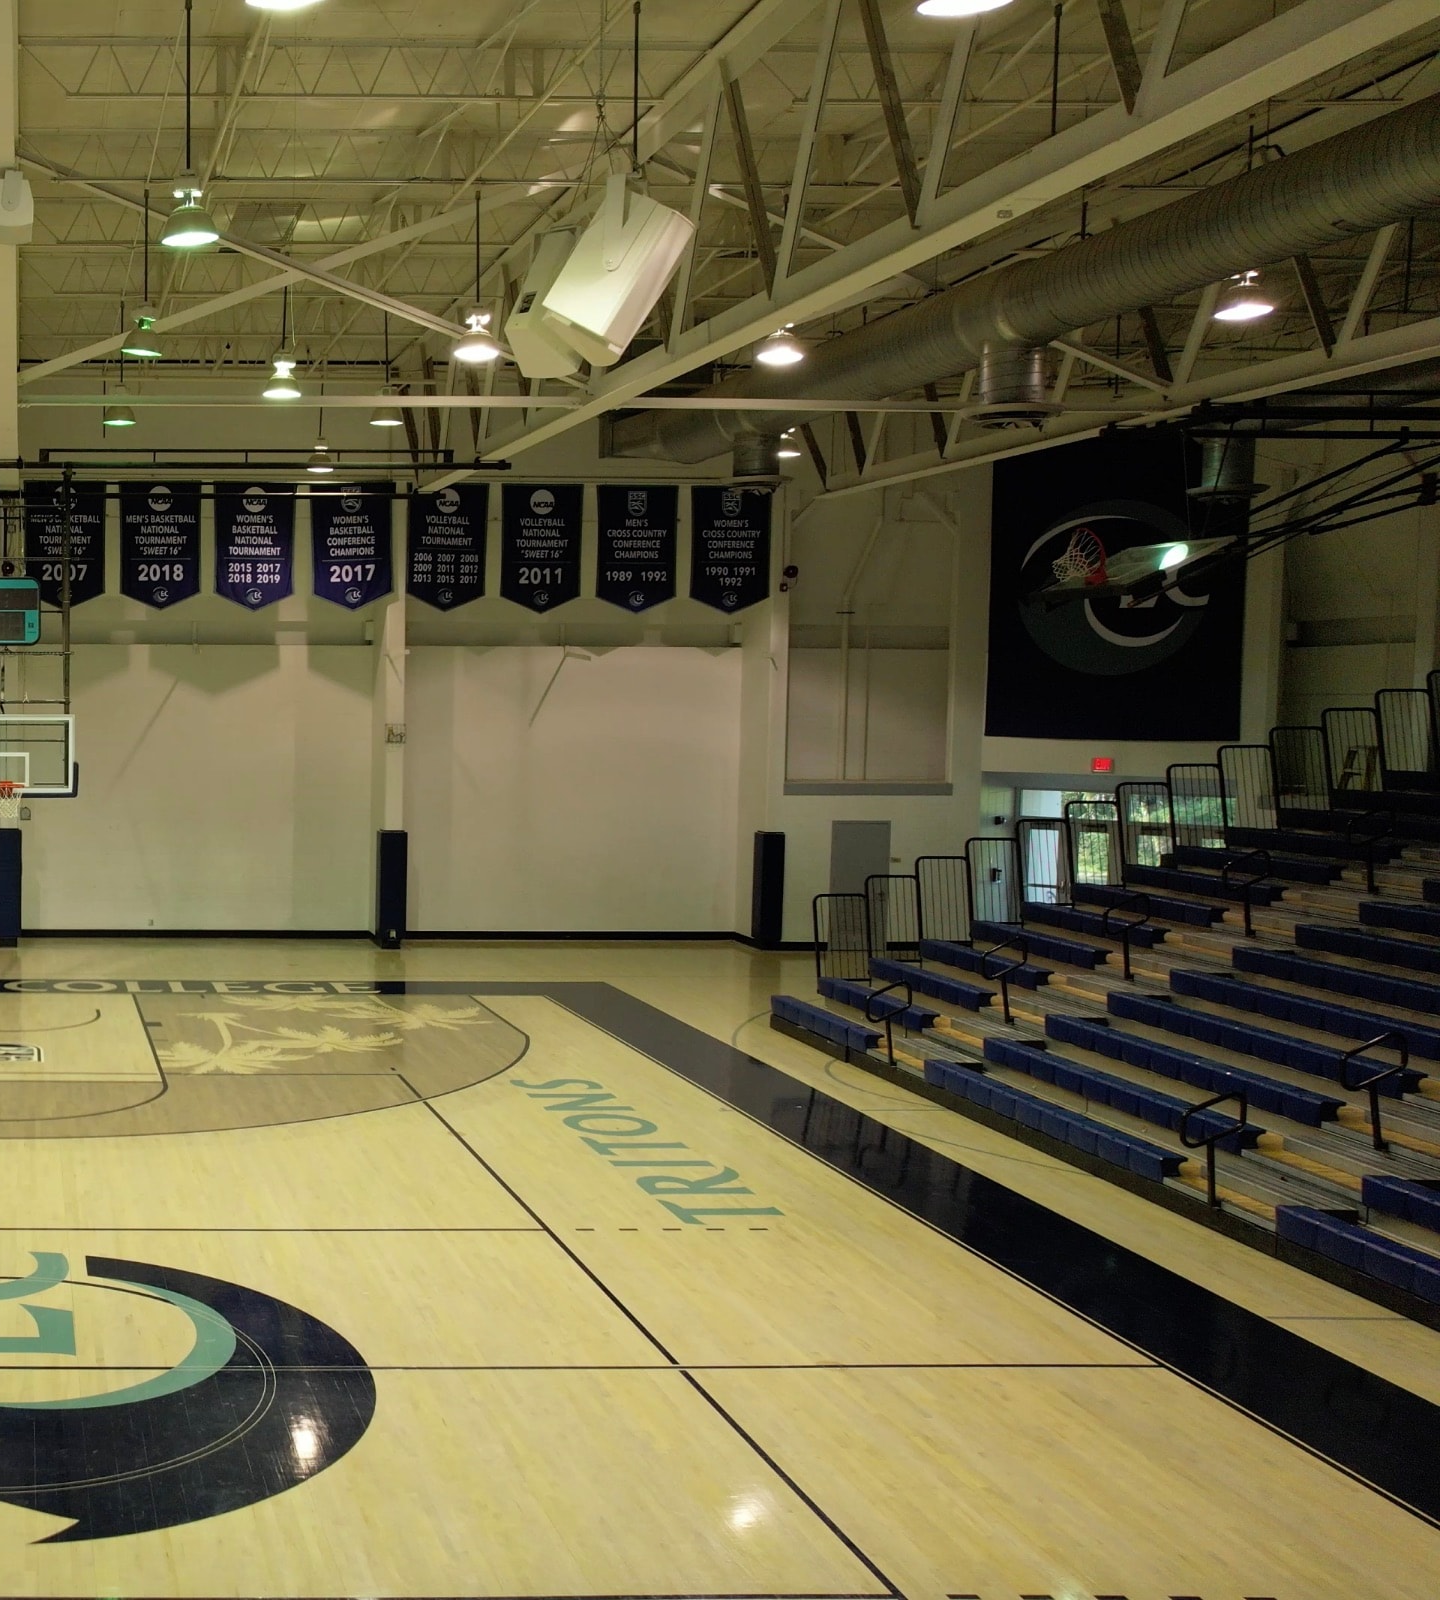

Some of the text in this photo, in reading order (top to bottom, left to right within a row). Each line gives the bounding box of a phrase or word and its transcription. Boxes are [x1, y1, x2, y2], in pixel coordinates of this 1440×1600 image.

[126, 515, 196, 523] MEN'S BASKETBALL
[236, 515, 273, 523] WOMEN'S
[333, 515, 369, 524] WOMEN'S
[426, 515, 470, 525] VOLLEYBALL
[520, 518, 565, 527] VOLLEYBALL
[626, 519, 649, 527] MEN'S
[714, 520, 749, 528] WOMEN'S
[141, 525, 179, 533] NATIONAL
[232, 525, 278, 534] BASKETBALL
[329, 526, 374, 535] BASKETBALL
[428, 526, 464, 535] NATIONAL
[523, 529, 560, 537] NATIONAL
[607, 529, 667, 538] CROSS COUNTRY
[702, 530, 761, 538] CROSS COUNTRY
[135, 536, 187, 544] TOURNAMENT
[235, 536, 273, 544] NATIONAL
[327, 536, 376, 546] CONFERENCE
[421, 536, 472, 546] TOURNAMENT
[516, 539, 568, 548] TOURNAMENT
[613, 540, 661, 548] CONFERENCE
[708, 540, 755, 549] CONFERENCE
[228, 547, 281, 556] TOURNAMENT
[329, 547, 374, 557] CHAMPIONS
[615, 550, 659, 559] CHAMPIONS
[709, 550, 753, 559] CHAMPIONS
[437, 554, 455, 562] 2007
[228, 563, 280, 572] 2015 2017
[437, 564, 454, 573] 2011
[460, 565, 478, 573] 2012
[706, 566, 755, 576] 1990 1991
[138, 564, 184, 581] 2018
[329, 564, 376, 583] 2017
[519, 567, 562, 584] 2011
[606, 571, 667, 582] 1989 1992
[228, 574, 280, 583] 2018 2019
[413, 574, 478, 584] 2013 2015 2017
[719, 577, 742, 586] 1992
[2, 979, 382, 995] COLLEGE
[510, 1079, 785, 1225] TRITONS
